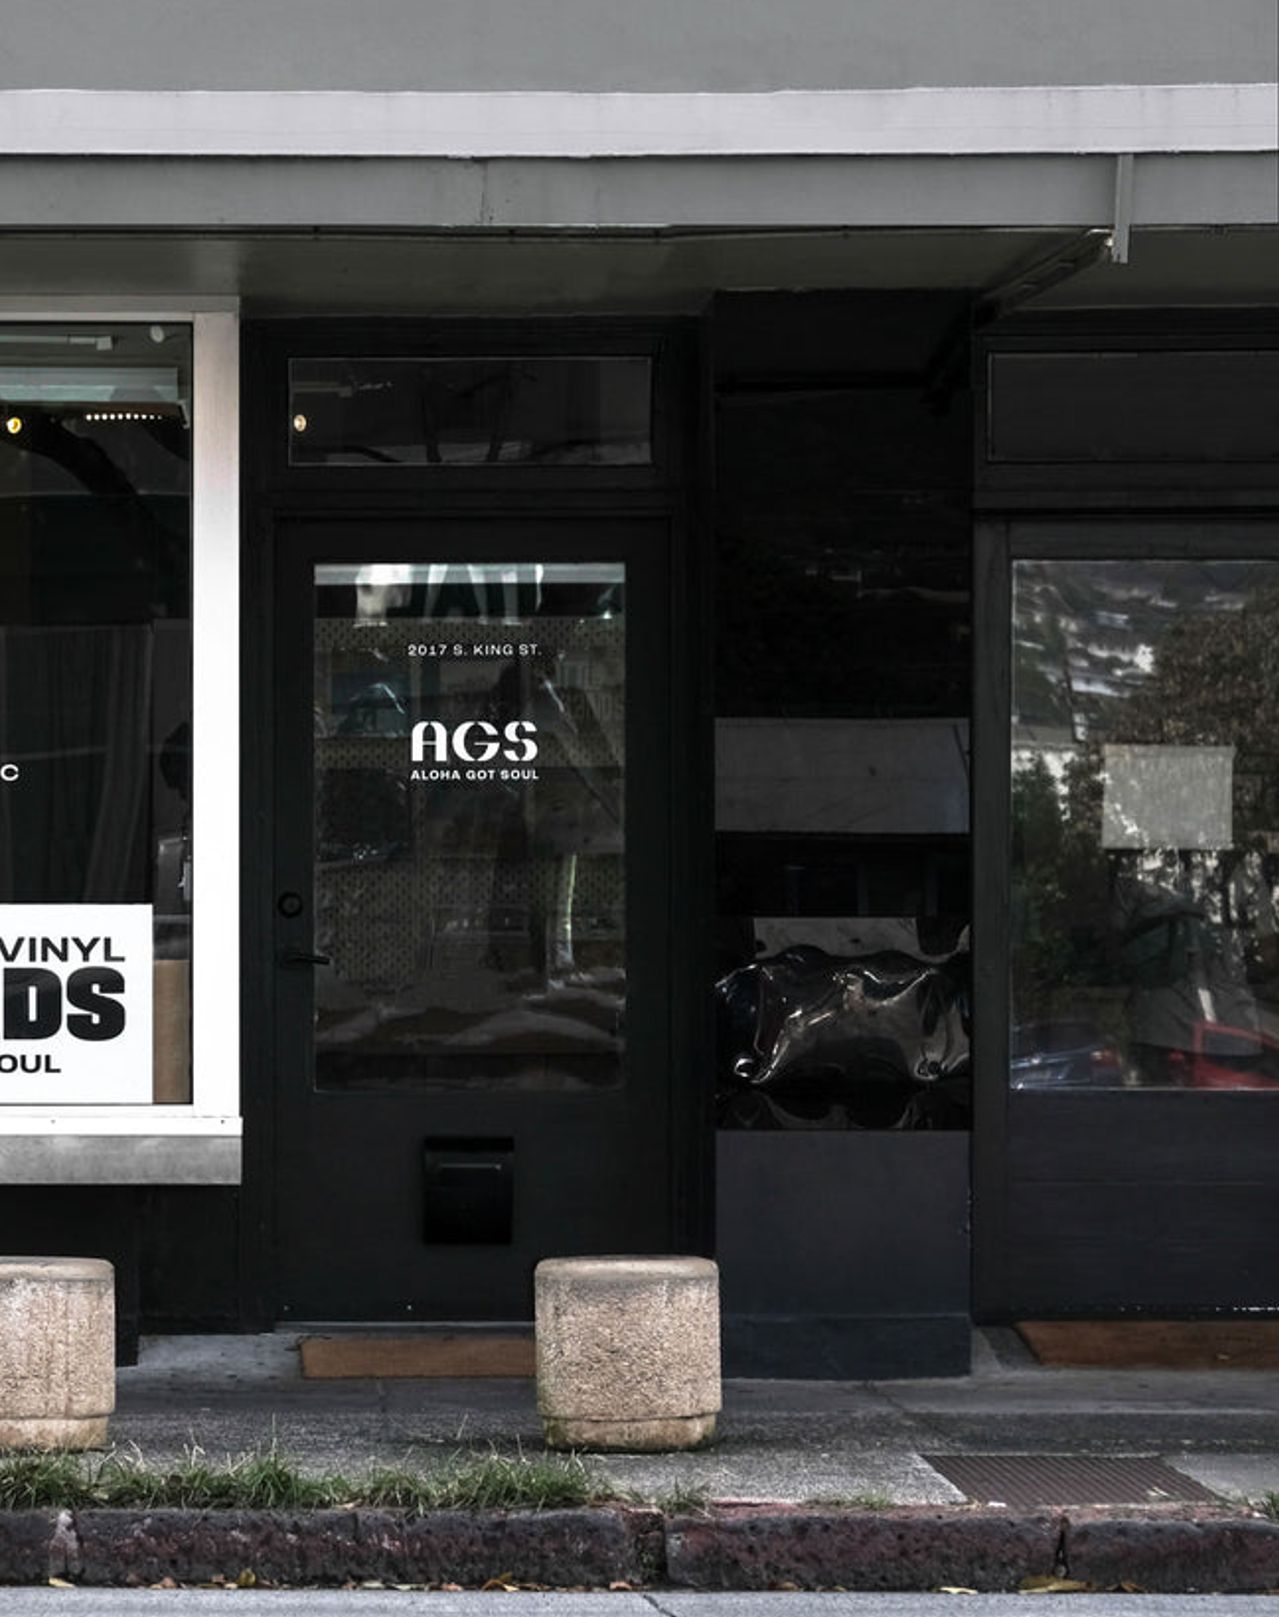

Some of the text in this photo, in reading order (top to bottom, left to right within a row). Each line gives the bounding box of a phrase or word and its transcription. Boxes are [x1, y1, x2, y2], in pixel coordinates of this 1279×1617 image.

[407, 643, 542, 657] 2017 S. KING ST.
[411, 720, 539, 762] AGS
[410, 769, 539, 781] ALOHA GOT SOUL
